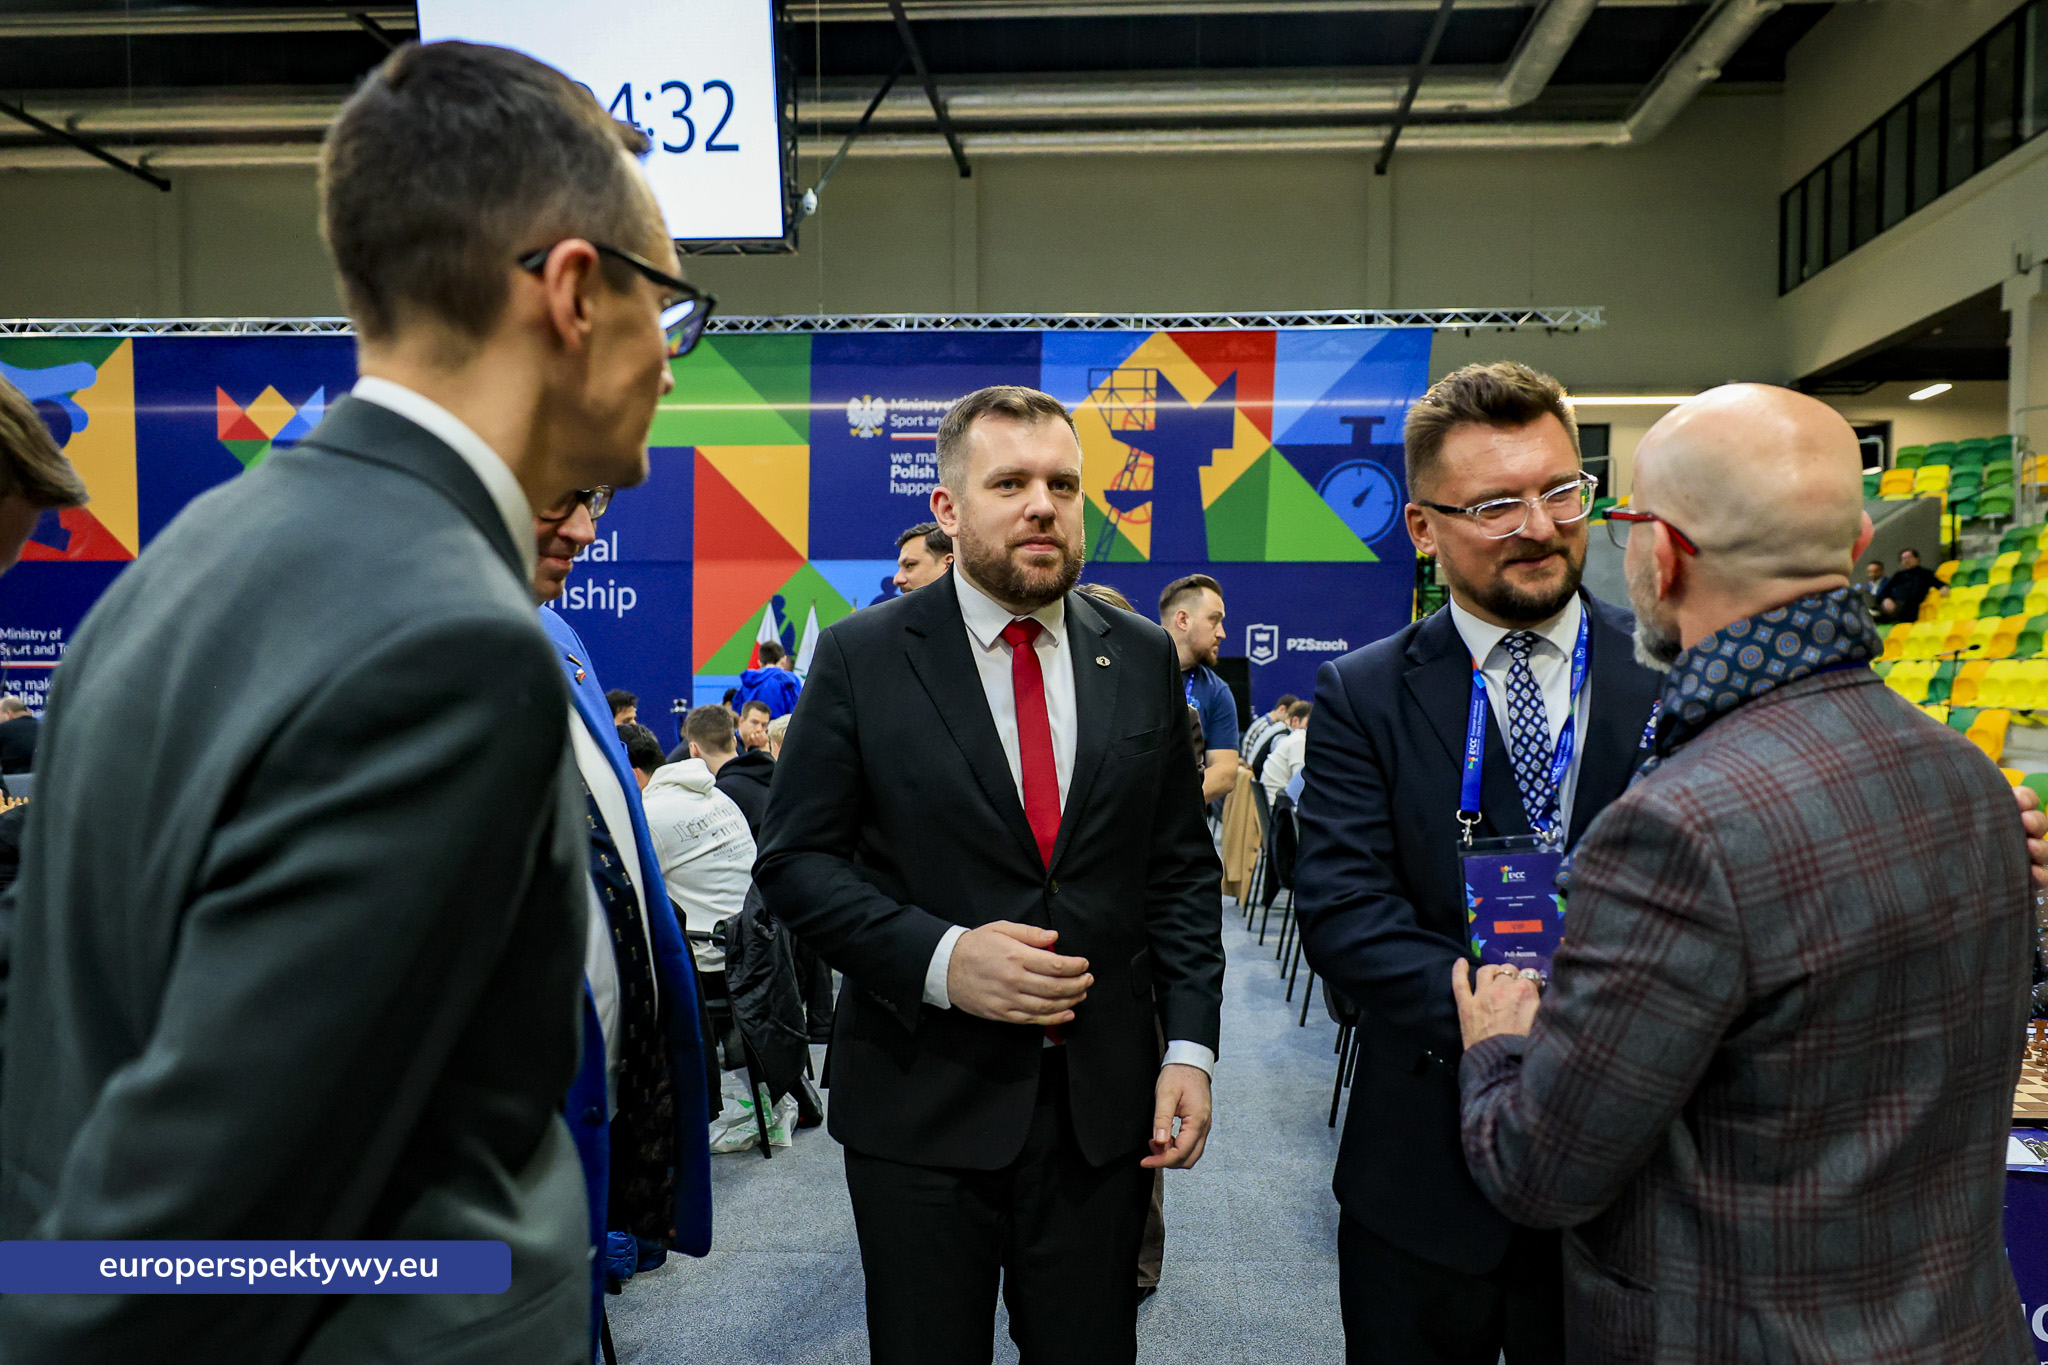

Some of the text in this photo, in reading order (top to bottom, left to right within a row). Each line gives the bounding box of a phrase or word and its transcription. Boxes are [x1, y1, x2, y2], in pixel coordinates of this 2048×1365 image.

[572, 79, 740, 154] 4:32
[890, 413, 942, 429] Sport an
[890, 452, 938, 464] we ma
[890, 464, 935, 479] Polish
[890, 480, 940, 496] happe
[0, 627, 62, 642] Ministry of
[33, 642, 56, 656] and
[24, 677, 53, 691] mak
